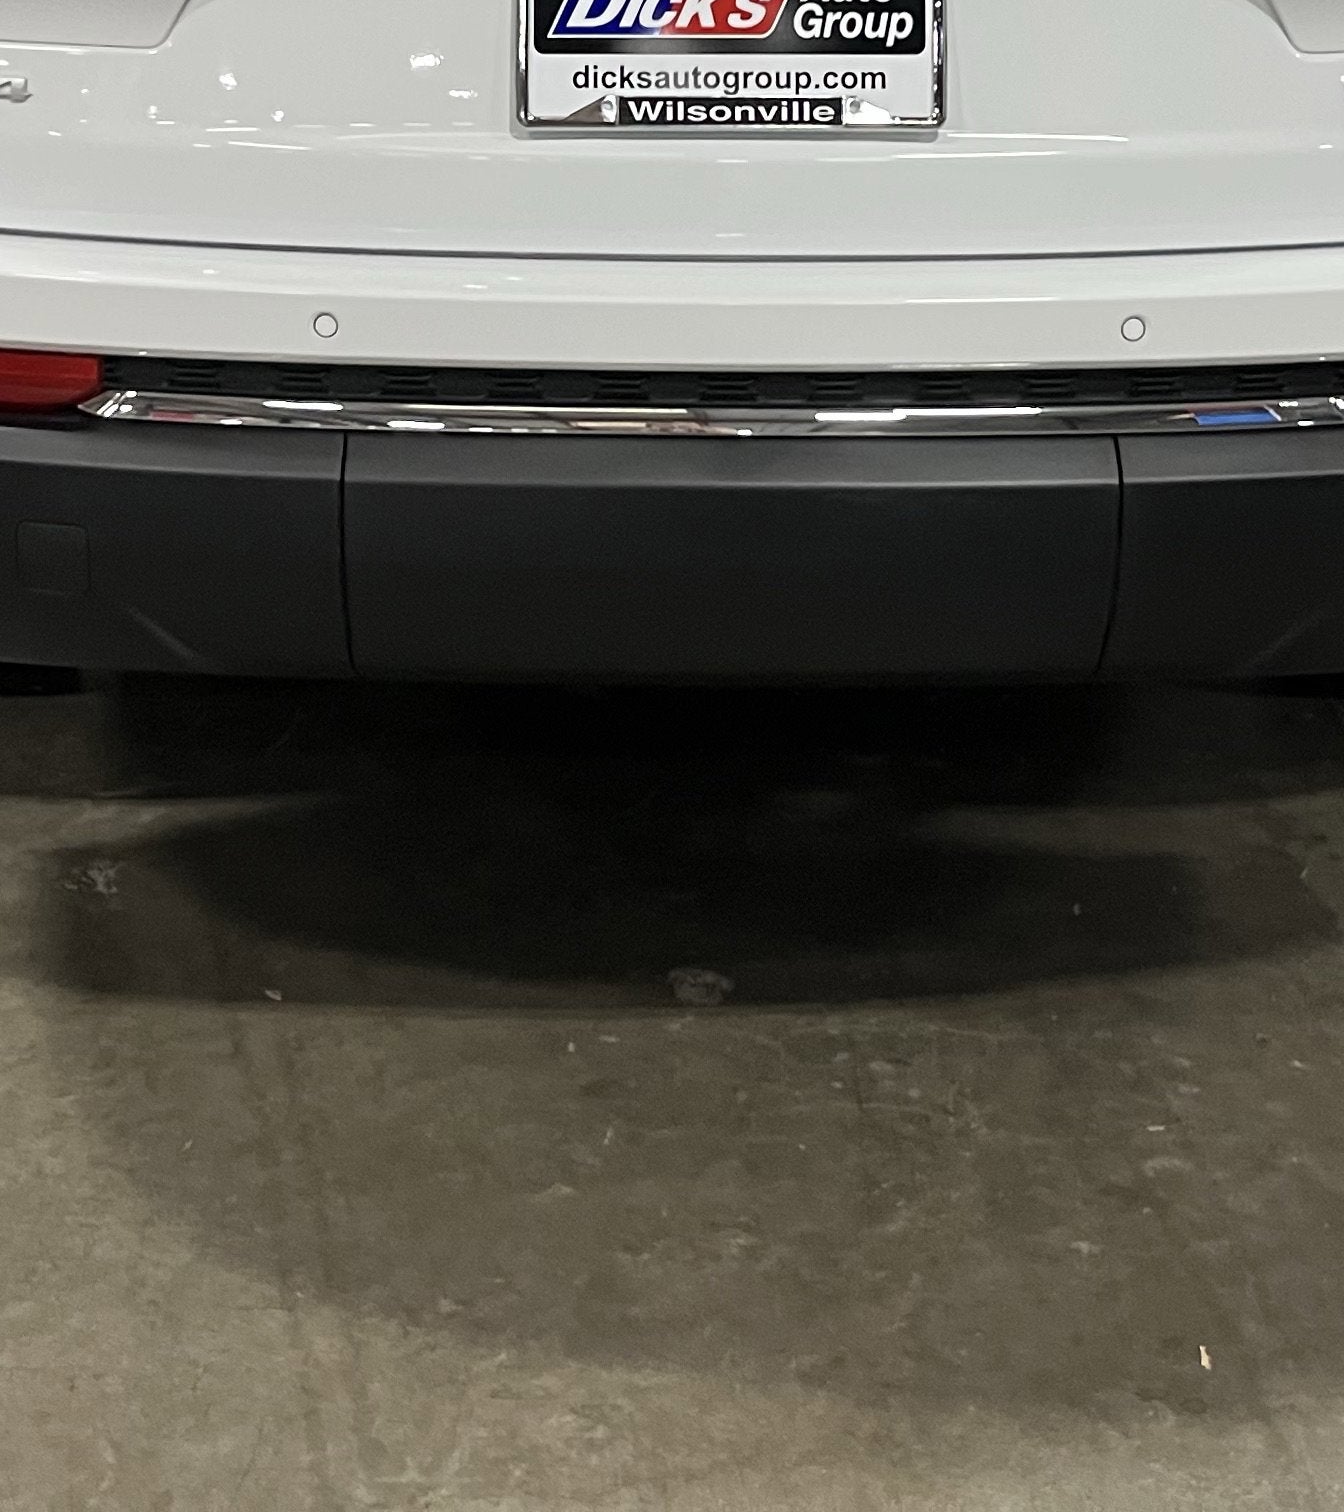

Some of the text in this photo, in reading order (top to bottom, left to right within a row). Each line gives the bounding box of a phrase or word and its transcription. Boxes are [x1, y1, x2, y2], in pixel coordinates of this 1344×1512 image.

[793, 3, 914, 48] Group
[572, 65, 887, 95] dicksautogroup.com
[628, 100, 835, 123] Wilsonville
